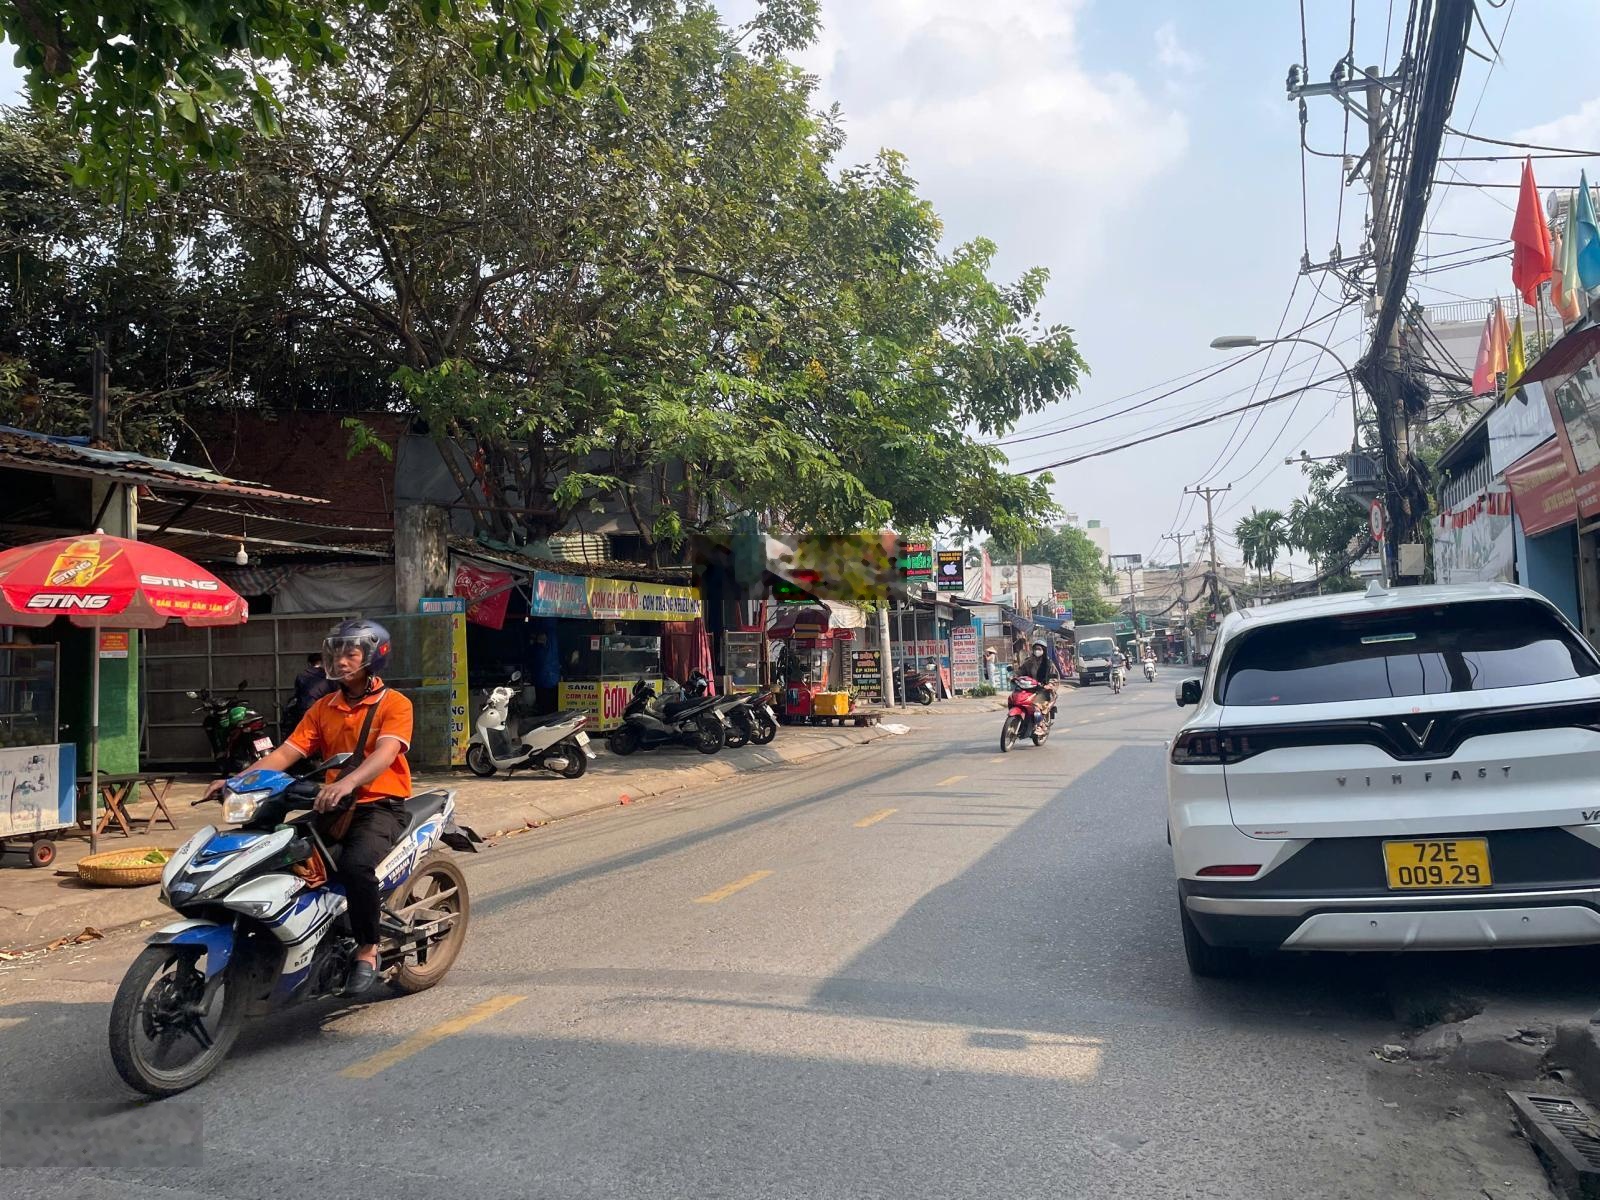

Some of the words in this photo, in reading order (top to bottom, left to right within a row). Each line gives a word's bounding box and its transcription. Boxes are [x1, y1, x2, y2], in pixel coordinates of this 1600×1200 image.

[51, 560, 93, 586] STING
[140, 574, 219, 591] STING
[25, 593, 112, 609] STING
[1336, 766, 1511, 787] VINFAST
[1413, 842, 1458, 863] 72E
[1398, 864, 1481, 886] 009.29
